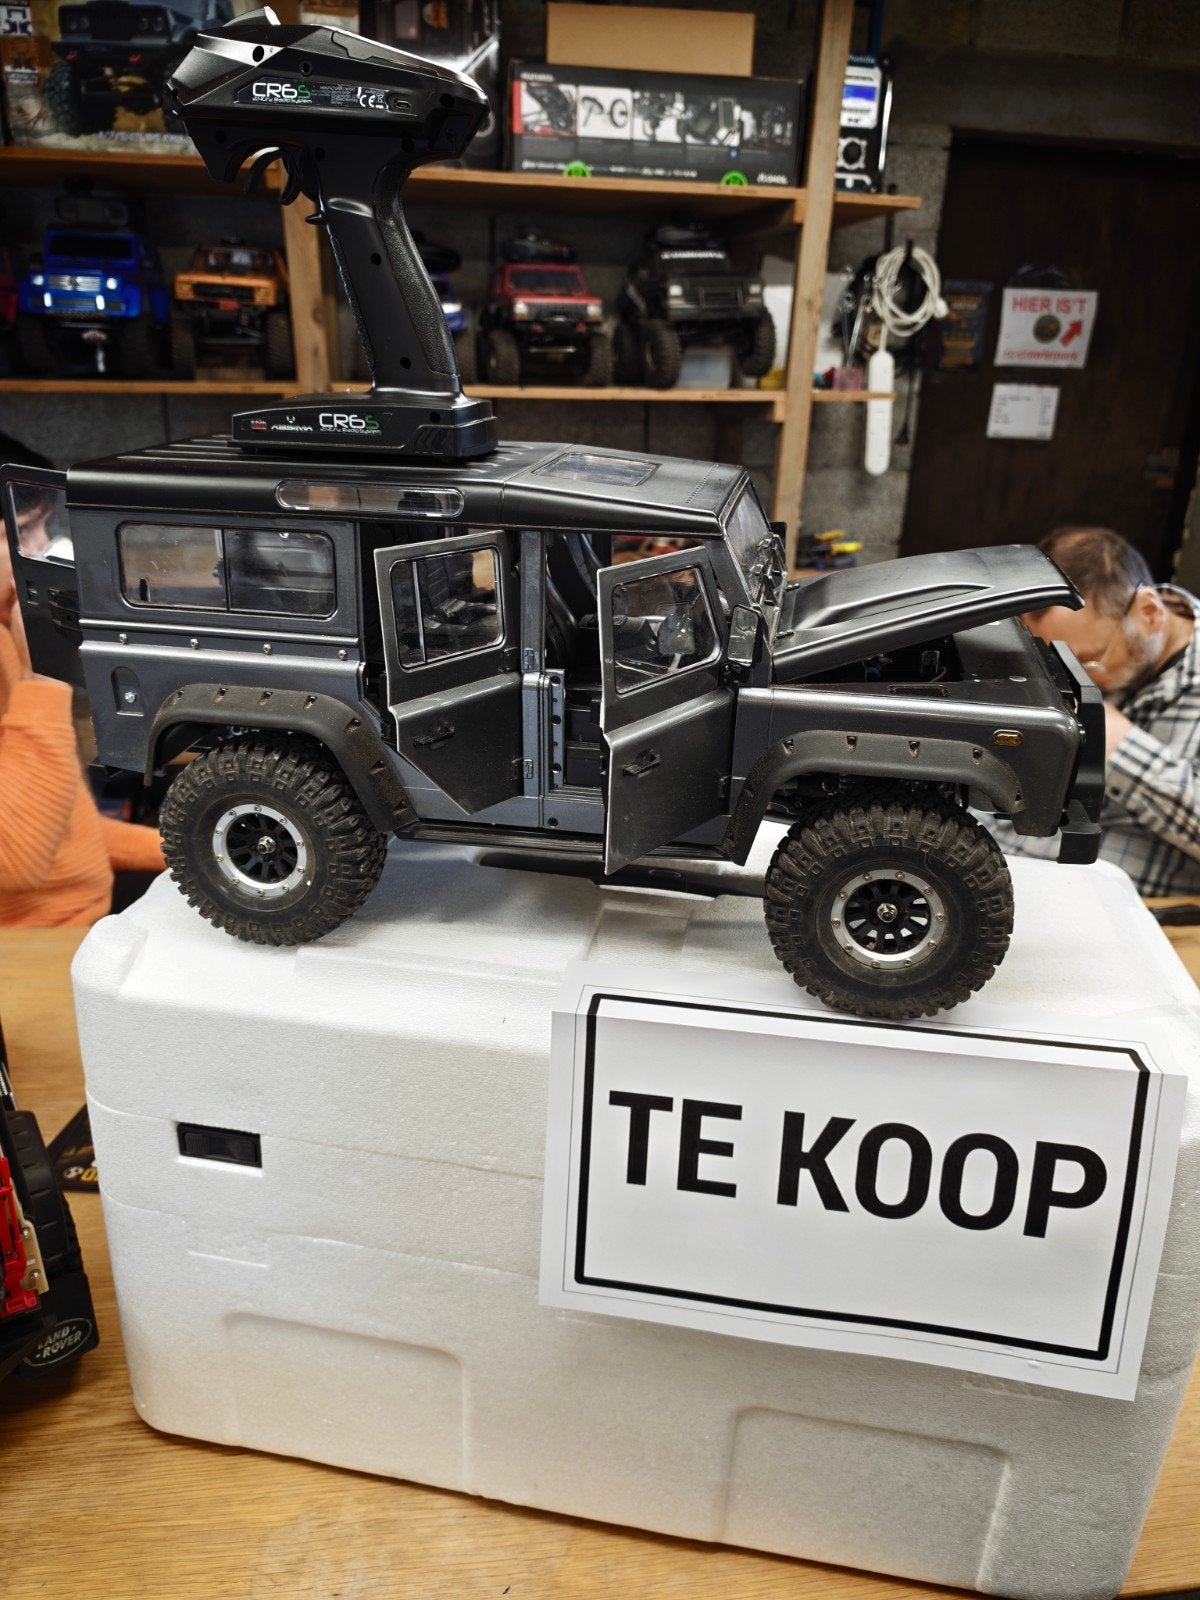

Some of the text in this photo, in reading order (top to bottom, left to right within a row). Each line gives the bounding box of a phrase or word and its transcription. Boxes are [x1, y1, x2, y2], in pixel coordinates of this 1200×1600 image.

[252, 82, 311, 99] CR6S
[1012, 296, 1051, 312] HIER
[319, 413, 380, 429] CR6S
[609, 1090, 1108, 1239] TE KOOP
